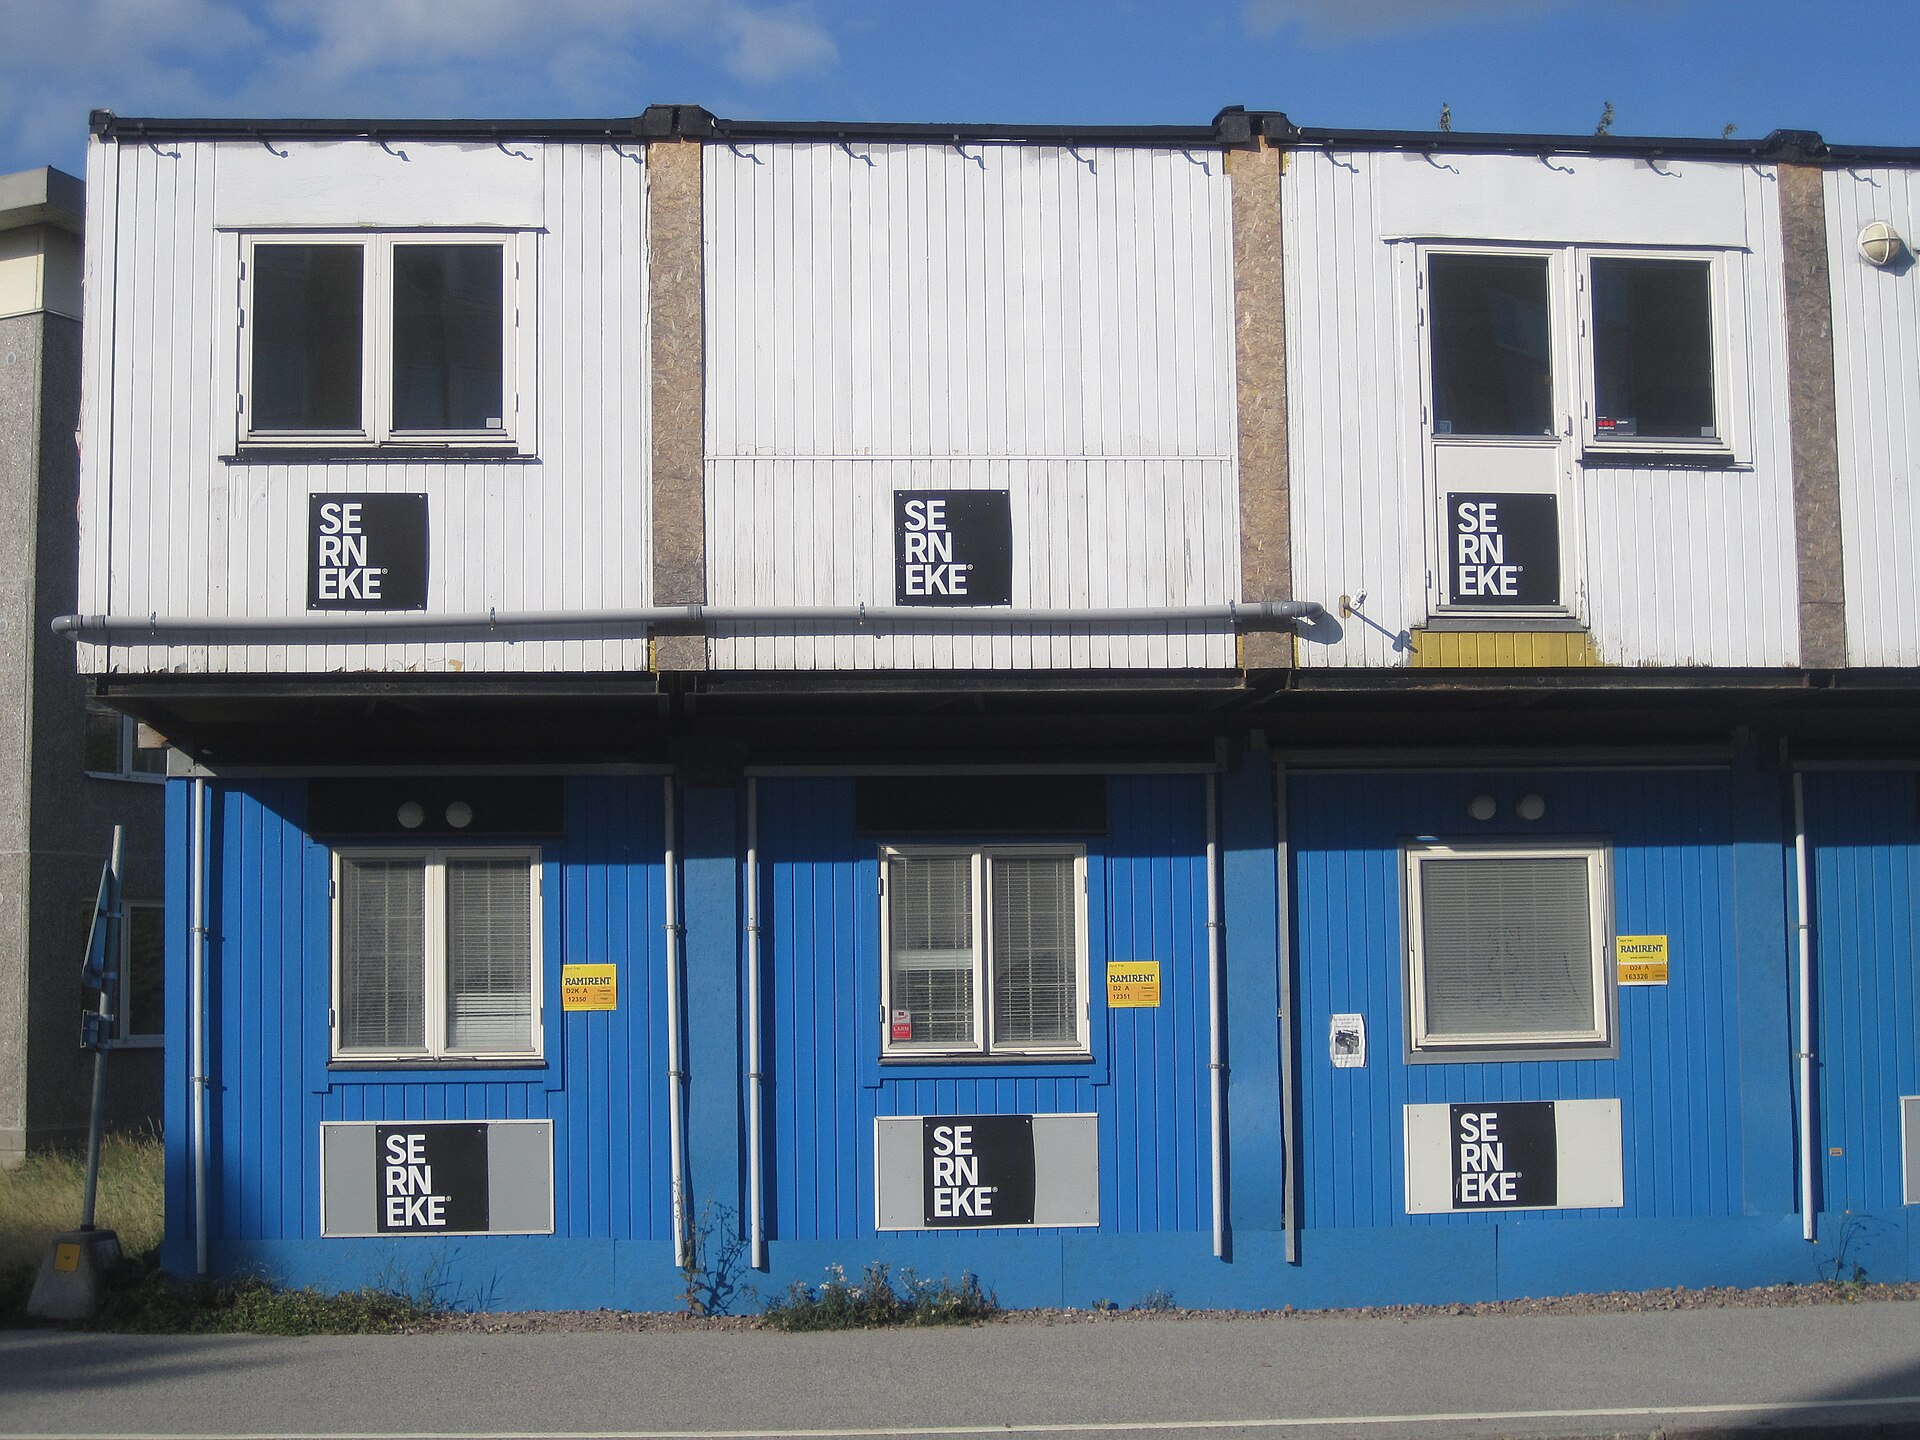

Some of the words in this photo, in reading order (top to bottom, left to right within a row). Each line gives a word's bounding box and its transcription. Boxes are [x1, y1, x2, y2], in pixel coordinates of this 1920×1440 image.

[319, 503, 362, 534] SE
[905, 500, 946, 531] SE
[1458, 502, 1497, 532] SE
[319, 536, 367, 566] RN
[905, 532, 952, 564] RN
[1459, 534, 1503, 564] RN
[1620, 944, 1663, 953] RAMIRENT
[565, 976, 611, 986] RAMIRENT
[1109, 974, 1155, 983] RAMIRENT
[933, 1126, 972, 1156] SE
[1460, 1113, 1498, 1142] SE
[386, 1134, 425, 1164] SE
[1461, 1143, 1503, 1172] RN
[386, 1165, 431, 1195] RN
[934, 1157, 978, 1186] RN
